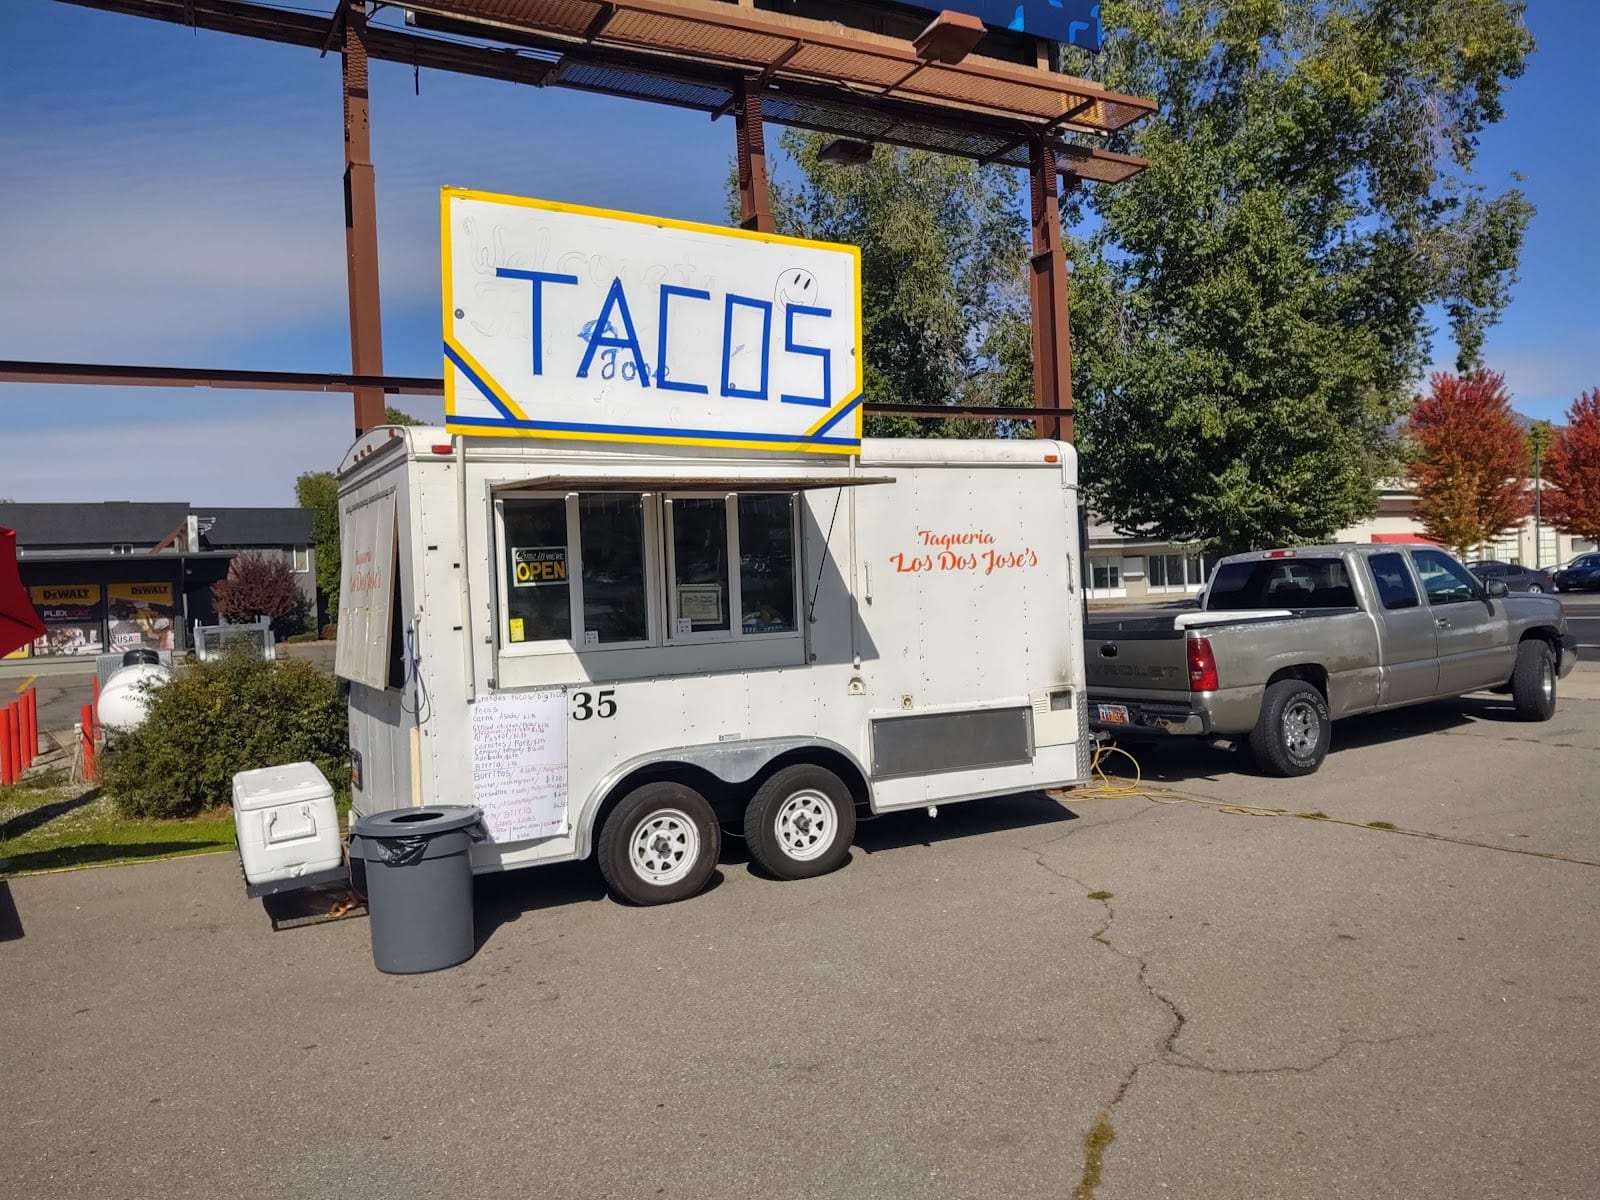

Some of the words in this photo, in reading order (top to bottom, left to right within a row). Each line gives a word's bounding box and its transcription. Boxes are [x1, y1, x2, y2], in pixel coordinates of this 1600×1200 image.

[496, 268, 832, 408] TACOS
[918, 530, 996, 549] Taqueria
[517, 561, 567, 581] OPEN
[889, 552, 934, 573] Los
[937, 550, 977, 571] Dos
[981, 547, 1038, 576] Jose's
[117, 635, 134, 645] USA
[572, 690, 617, 721] 35
